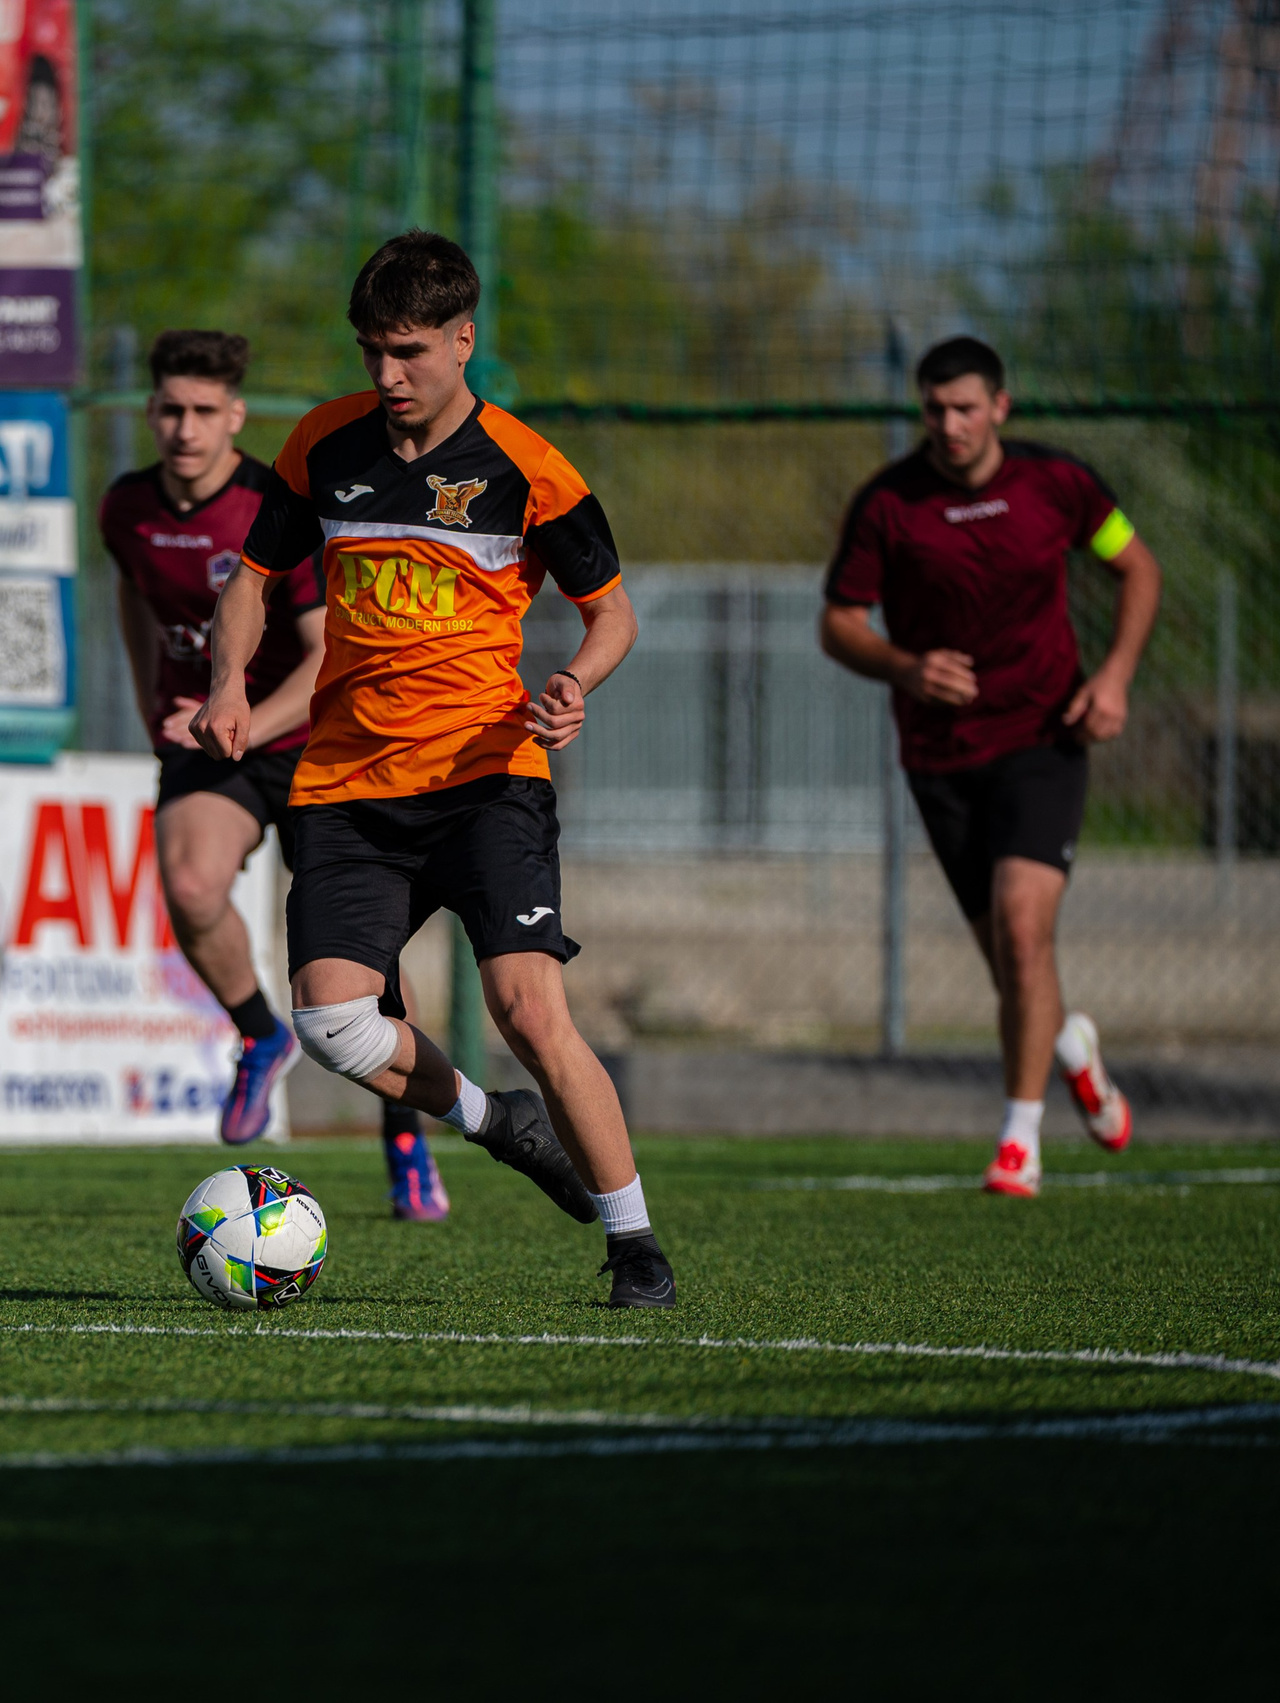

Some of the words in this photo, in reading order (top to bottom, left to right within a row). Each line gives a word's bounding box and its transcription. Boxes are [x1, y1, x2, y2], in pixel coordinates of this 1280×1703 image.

[337, 553, 461, 617] PCM
[386, 616, 442, 633] MODERN
[445, 619, 474, 632] 1992
